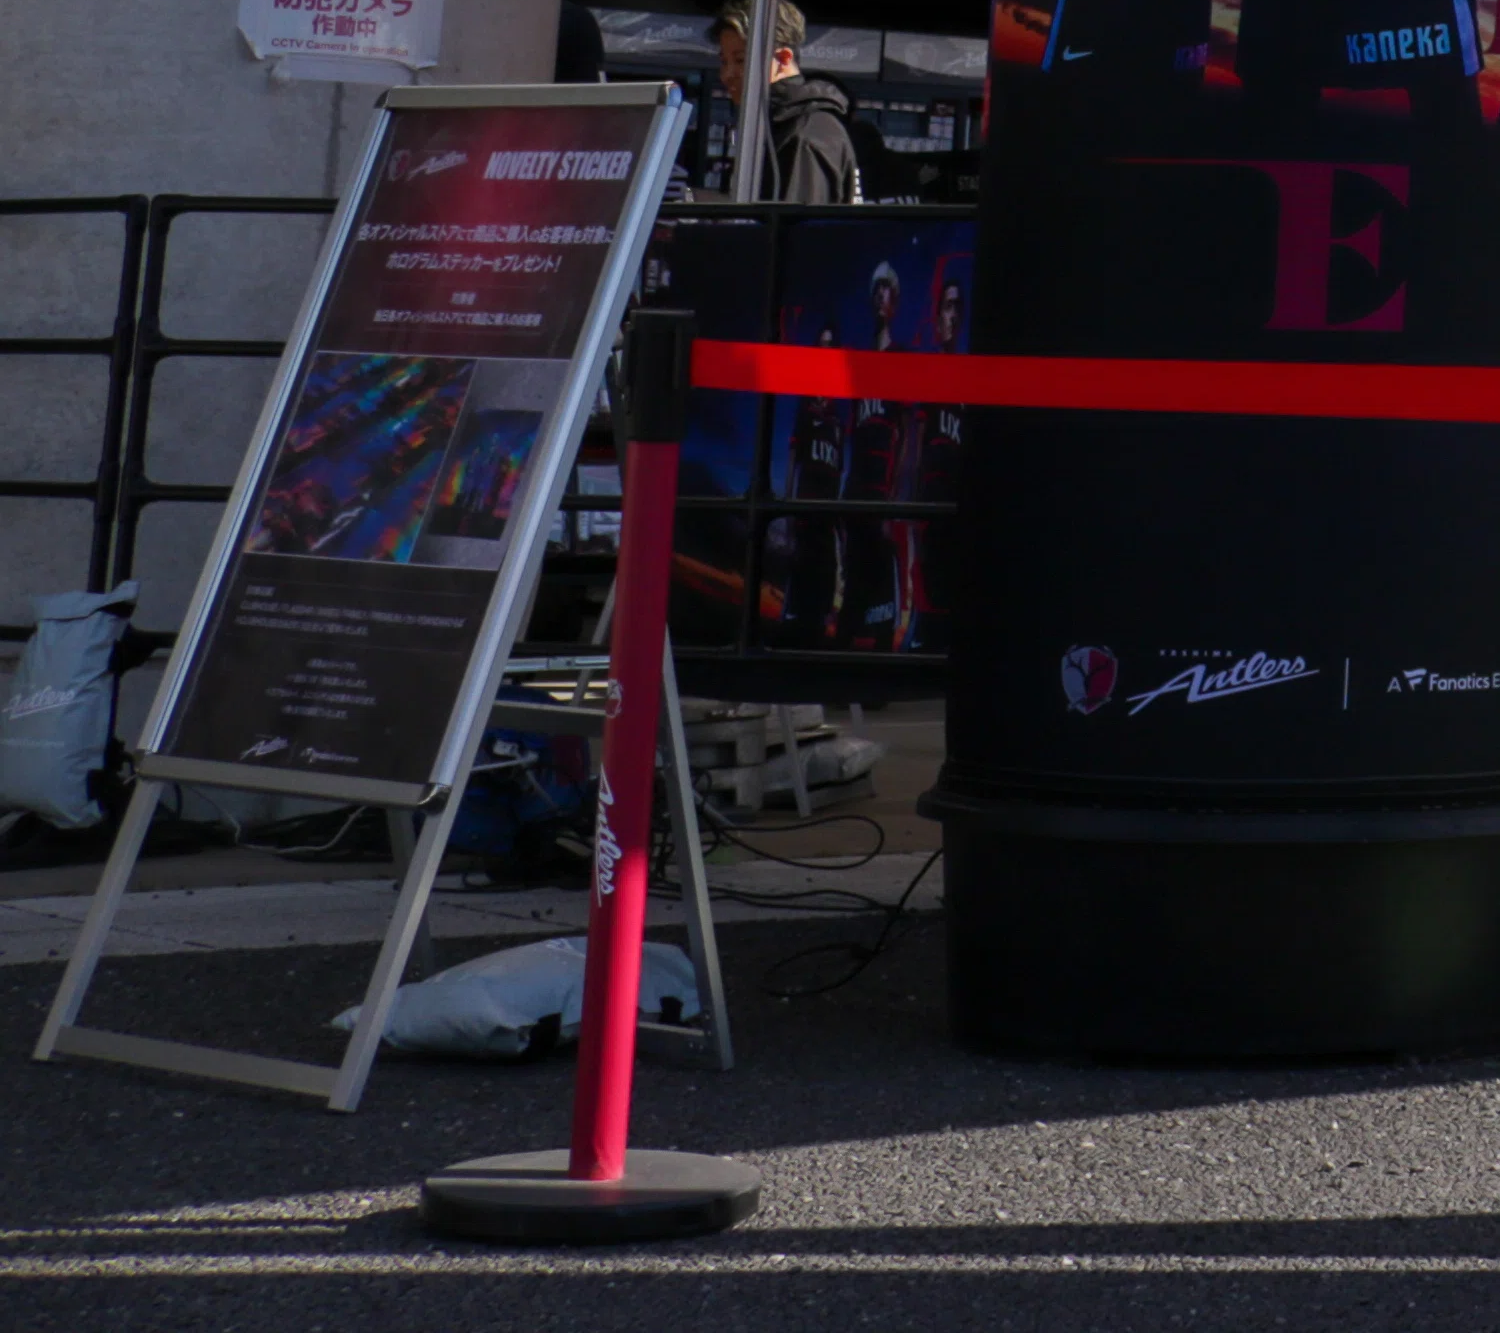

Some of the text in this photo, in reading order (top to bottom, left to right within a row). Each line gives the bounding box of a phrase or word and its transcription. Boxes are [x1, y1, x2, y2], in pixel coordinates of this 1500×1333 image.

[311, 13, 377, 39] 作動中
[270, 36, 303, 48] CCTV
[305, 39, 347, 52] Camera
[484, 150, 560, 181] NOVELTY
[557, 150, 633, 181] STICKER
[1126, 651, 1321, 716] Antlers
[1428, 672, 1491, 693] Fanatics
